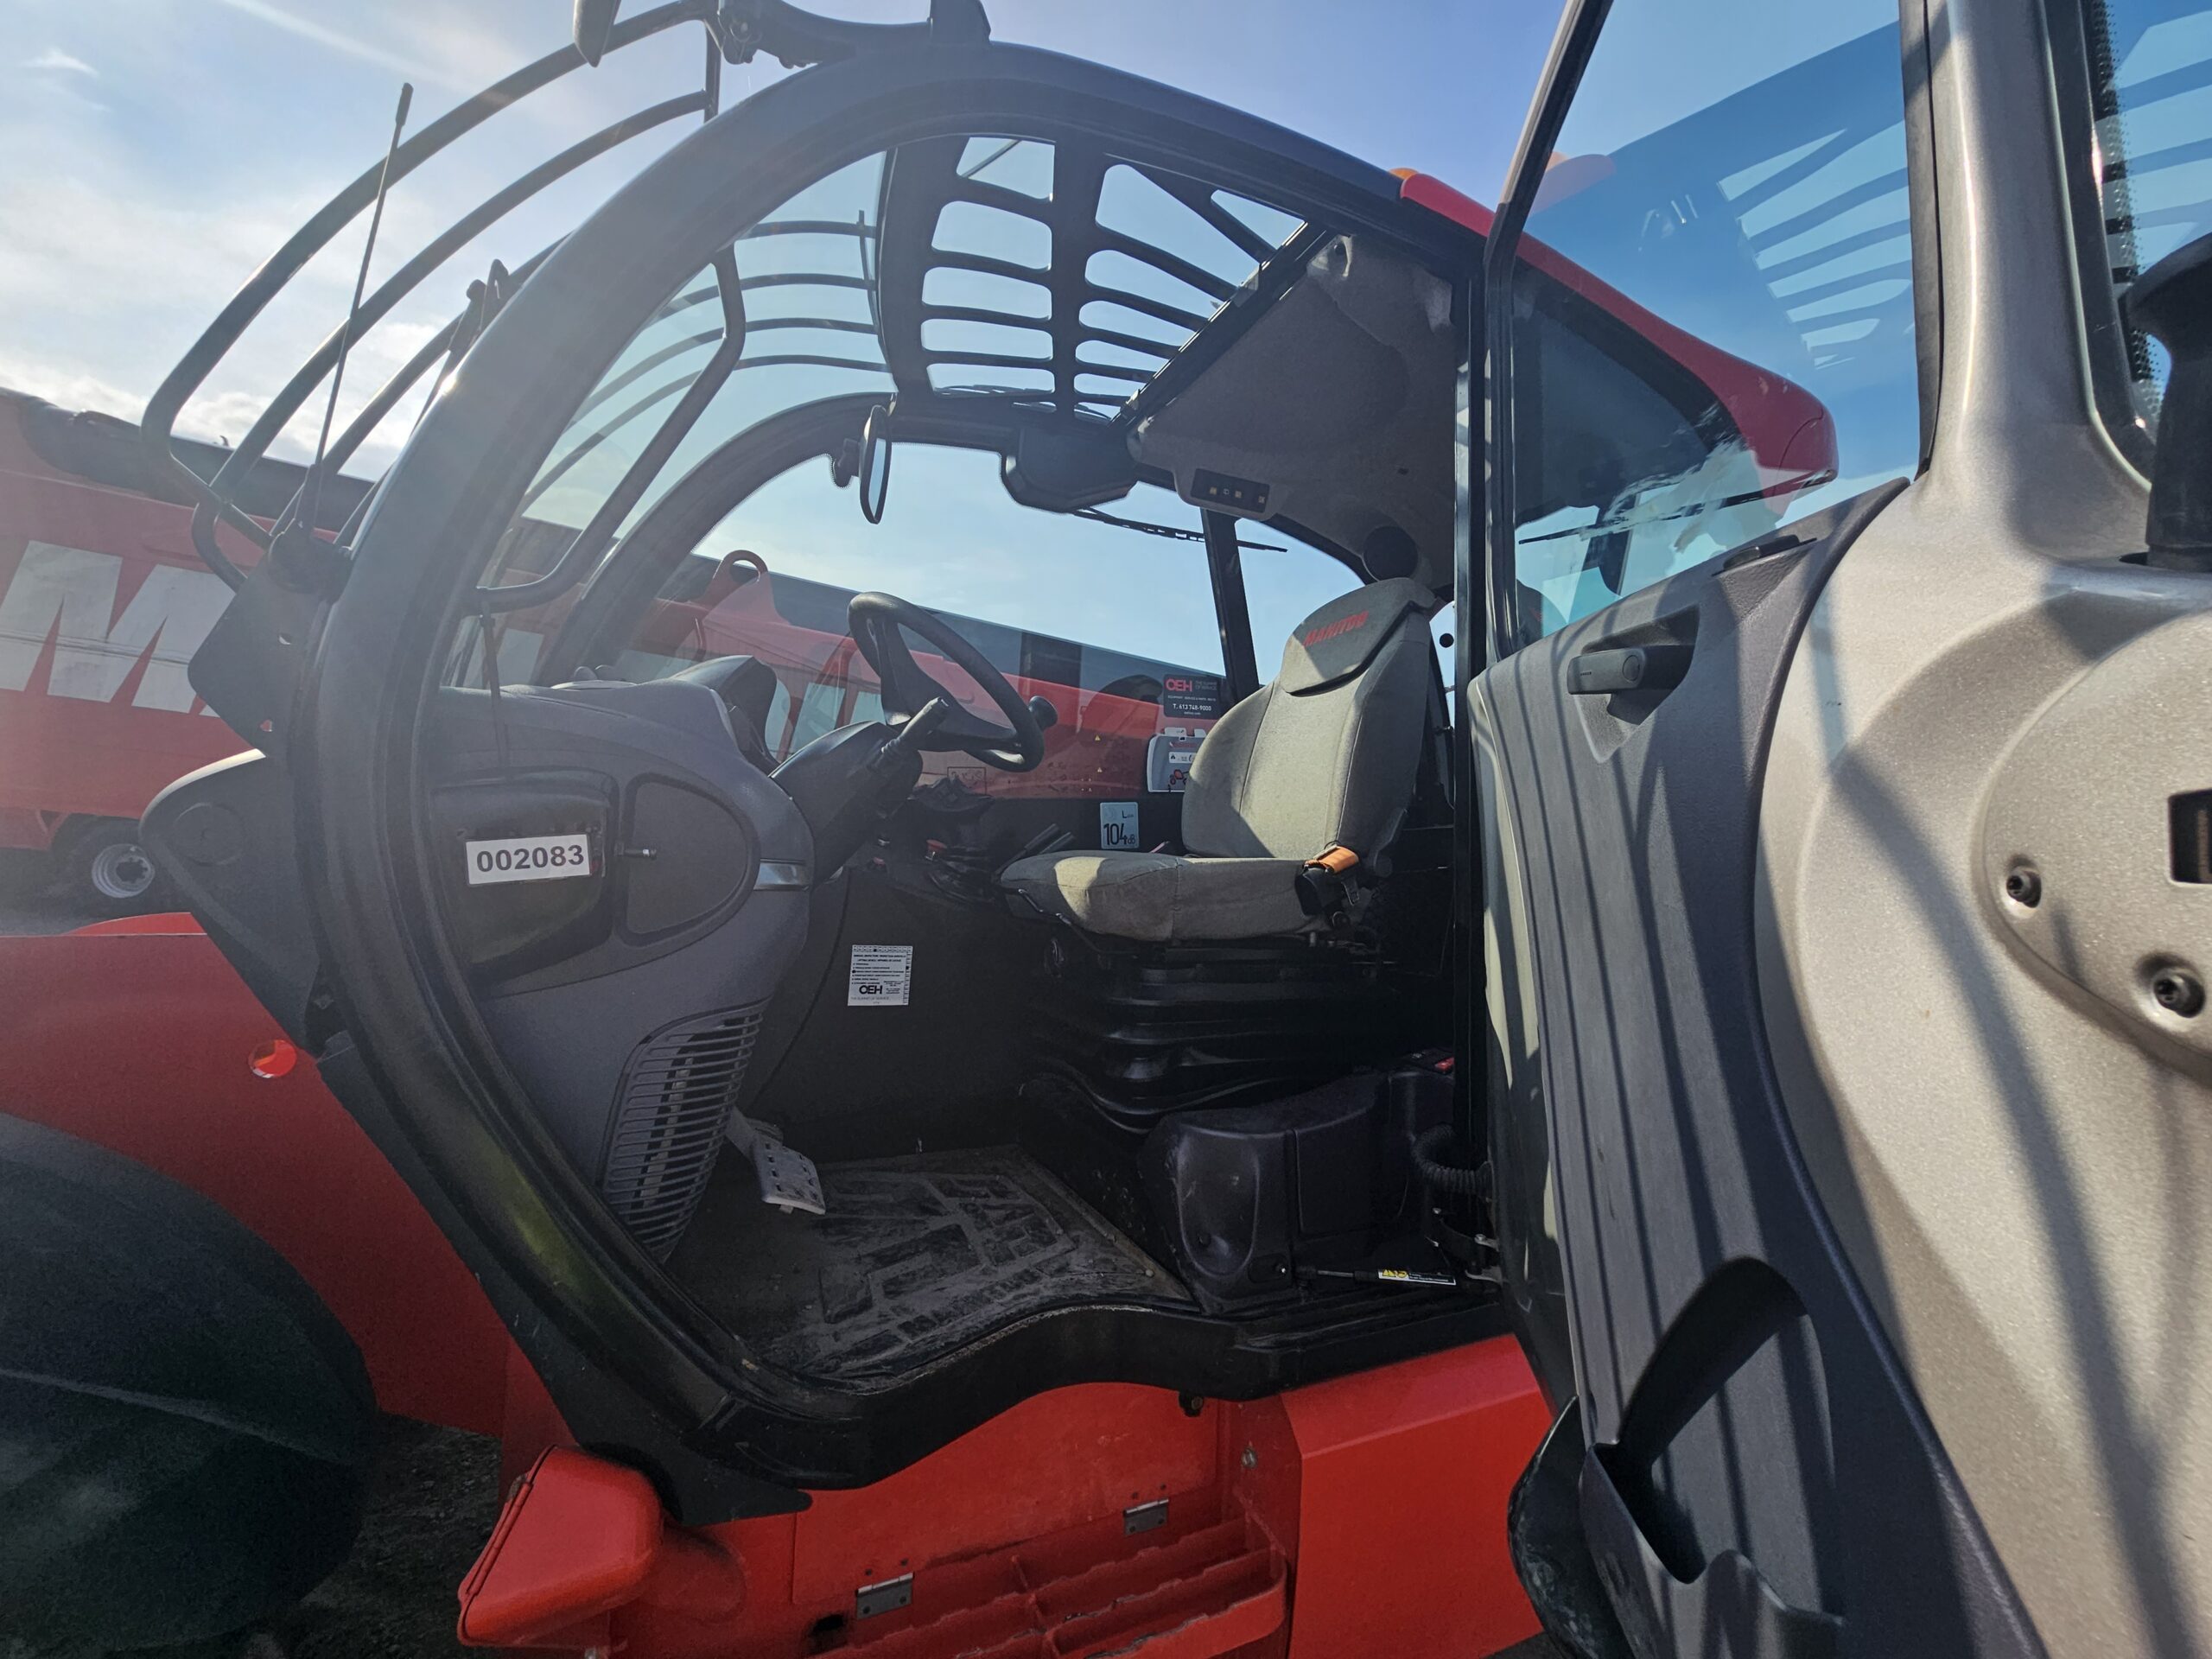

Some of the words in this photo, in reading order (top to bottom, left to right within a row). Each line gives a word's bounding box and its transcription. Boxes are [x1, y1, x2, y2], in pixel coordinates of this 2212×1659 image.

[1166, 678, 1192, 692] OEH
[1103, 823, 1128, 845] 104
[476, 844, 585, 873] 002083
[859, 985, 883, 995] OEH
